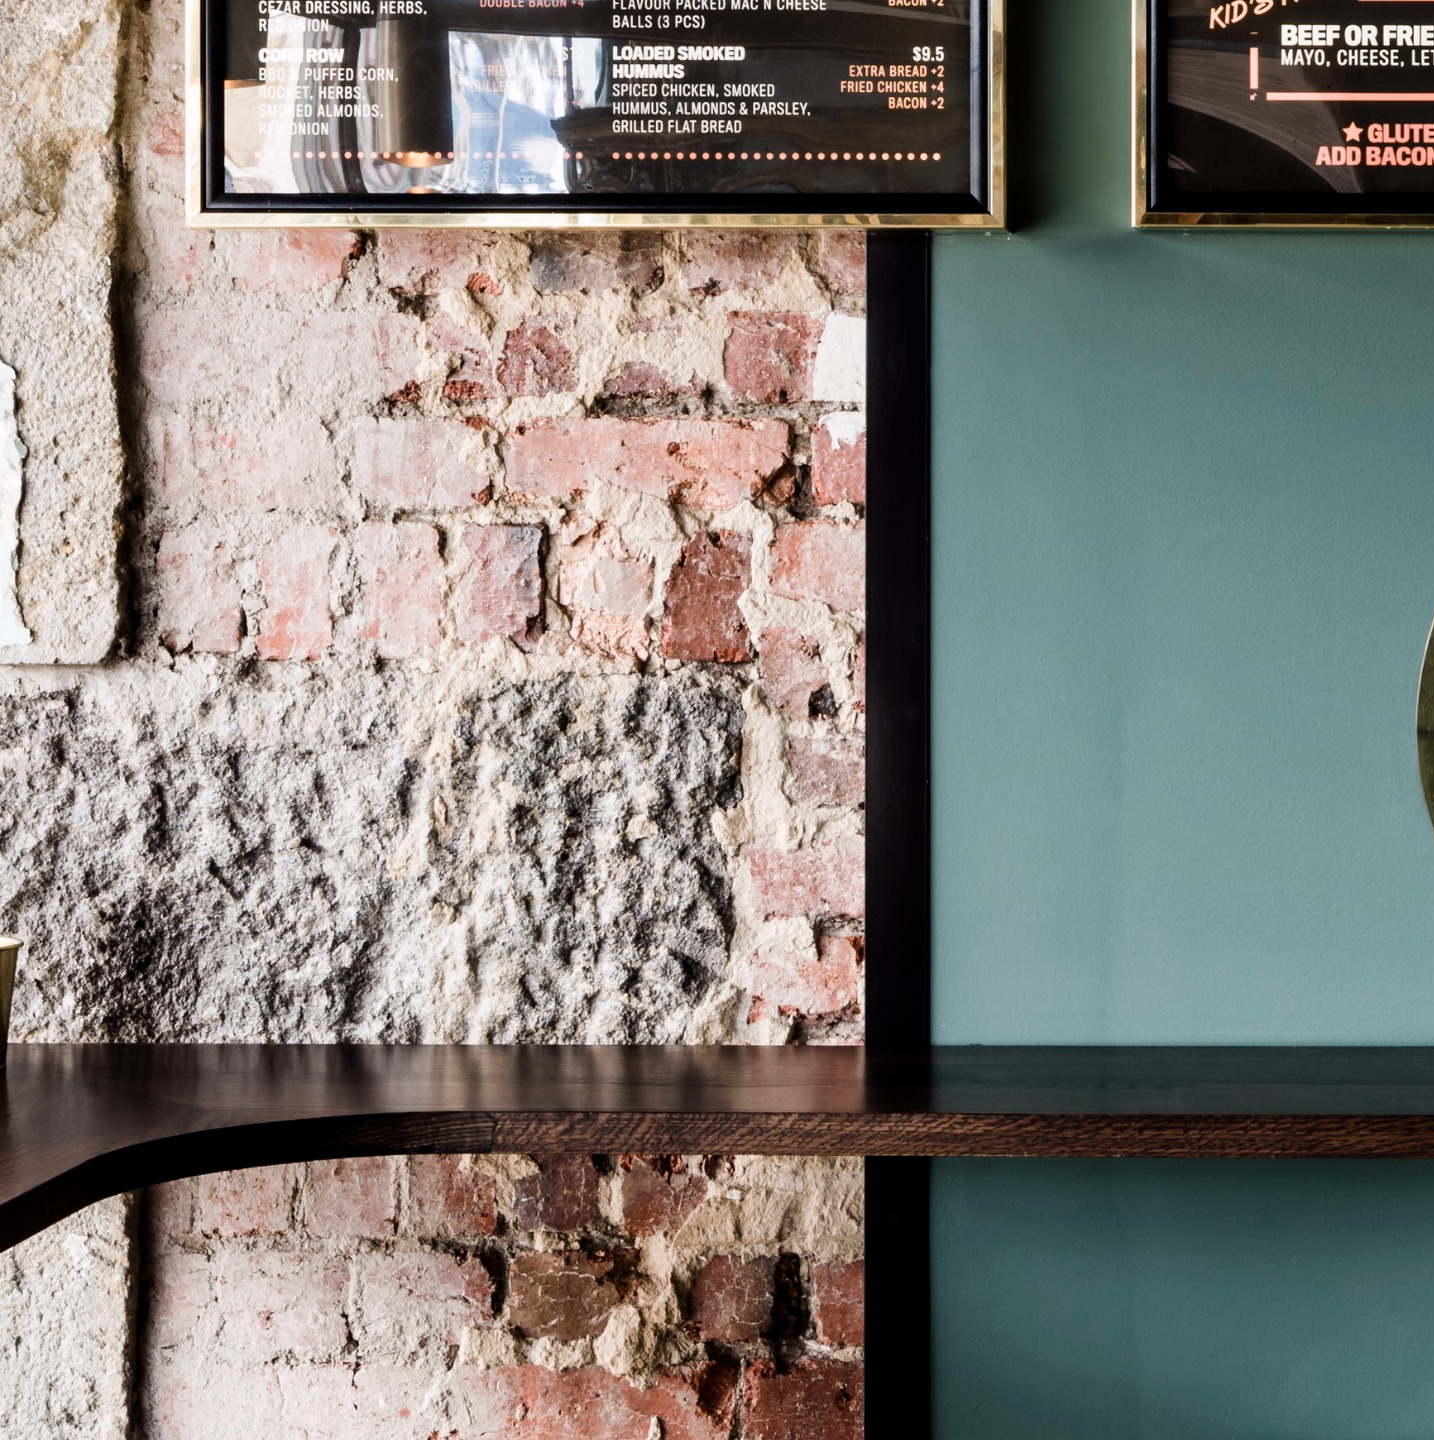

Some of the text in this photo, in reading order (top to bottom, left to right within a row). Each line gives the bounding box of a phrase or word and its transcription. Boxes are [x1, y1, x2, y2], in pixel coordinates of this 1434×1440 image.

[611, 119, 743, 134] GRILLED FLAT BREAD
